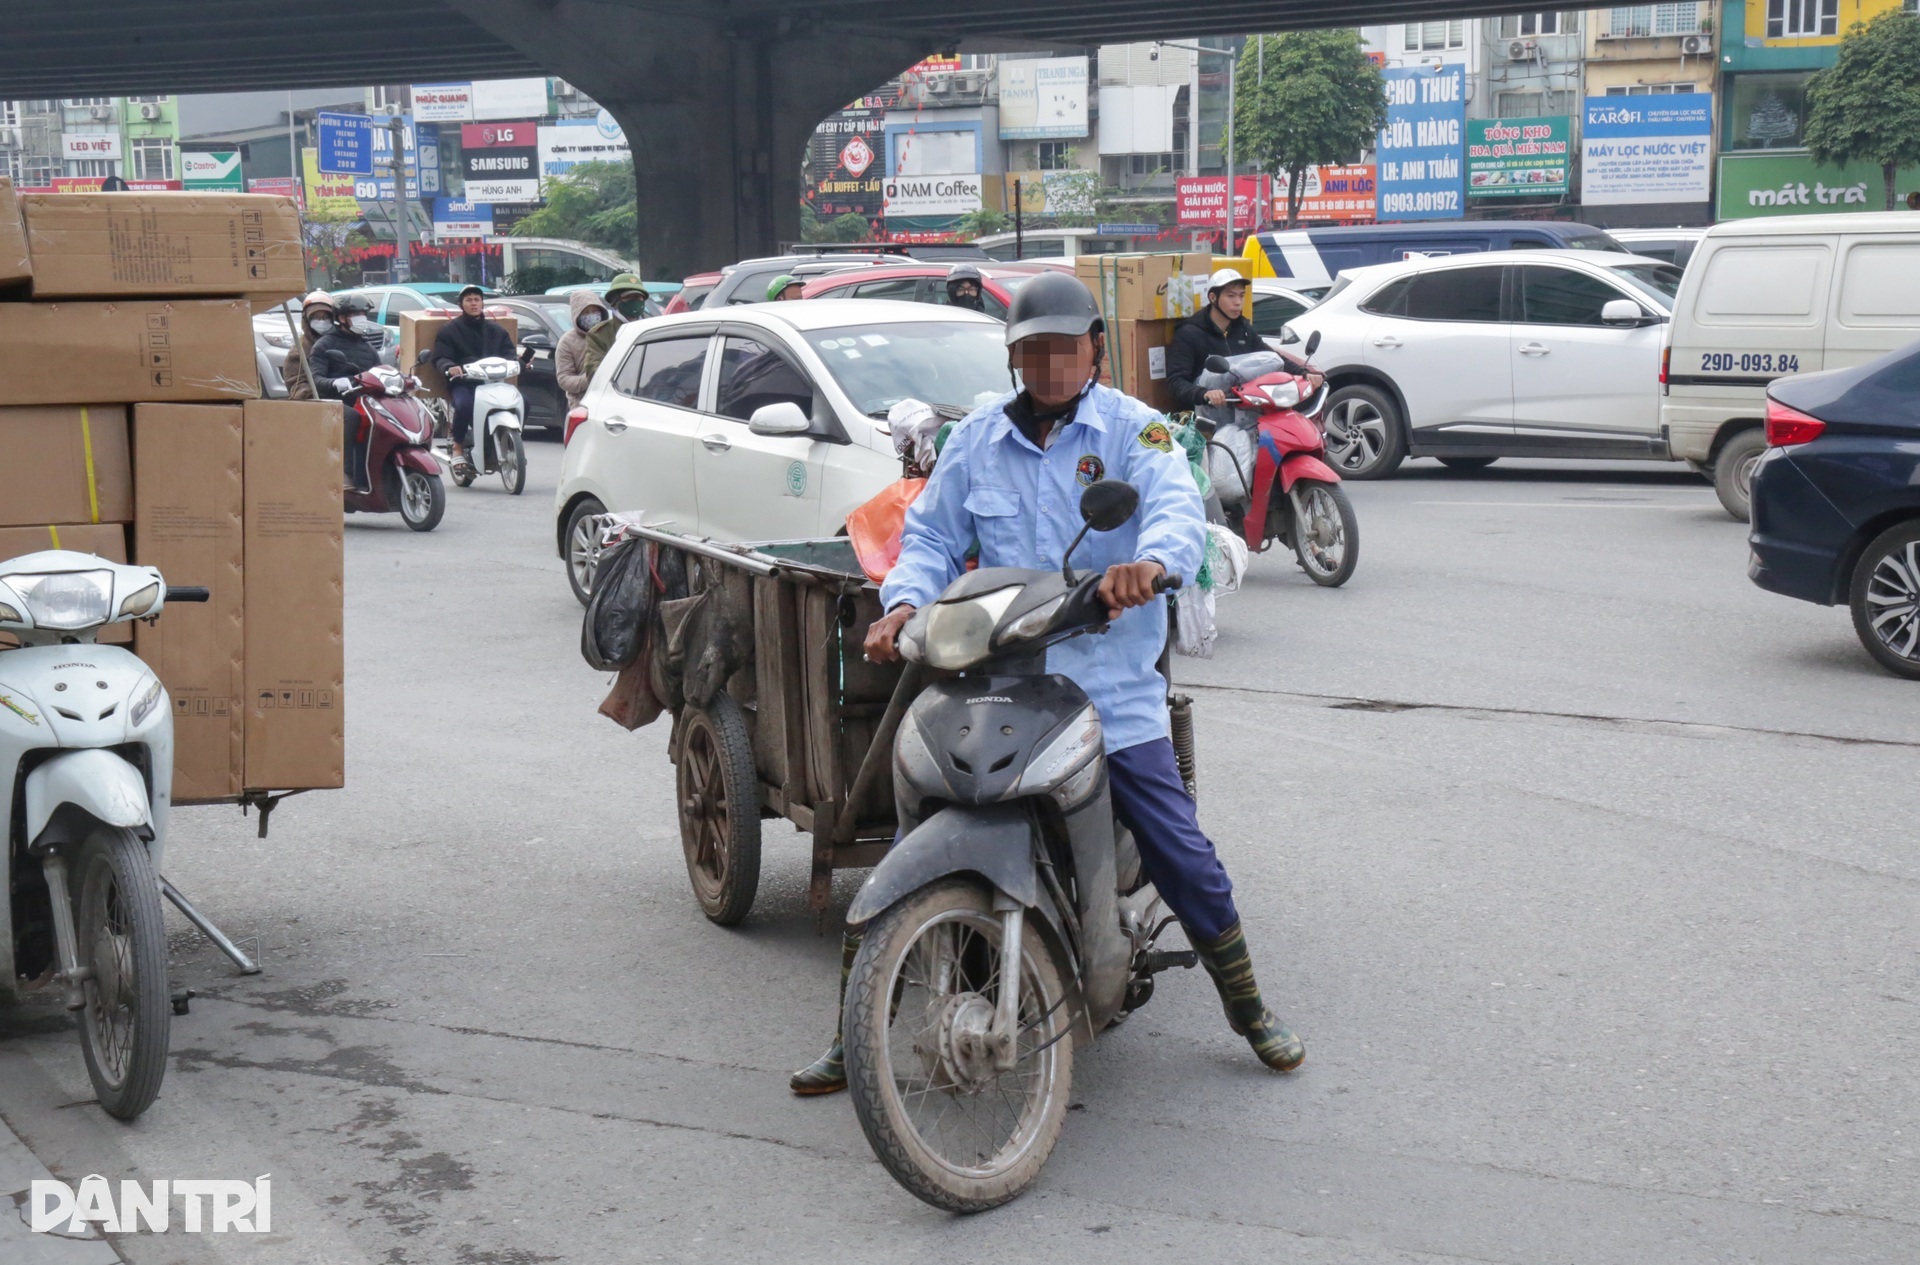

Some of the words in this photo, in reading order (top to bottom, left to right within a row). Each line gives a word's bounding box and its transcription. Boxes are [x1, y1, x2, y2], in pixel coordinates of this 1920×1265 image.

[1384, 78, 1416, 106] CHO
[1420, 70, 1460, 104] THUÊ
[438, 94, 468, 103] QUANG
[1588, 108, 1641, 124] KAROFI
[344, 120, 357, 128] CAO
[839, 122, 843, 133] 7
[1484, 121, 1520, 141] TỔNG
[1522, 125, 1552, 139] KHO
[497, 129, 514, 142] LG
[1382, 116, 1413, 149] CỬA
[1417, 116, 1459, 147] HÀNG
[70, 142, 88, 151] LED
[91, 139, 112, 152] VIỆT
[551, 145, 567, 153] CÔNG
[1469, 145, 1492, 157] HOA
[1492, 140, 1514, 158] QUẢ
[1542, 141, 1566, 154] NAM
[1588, 144, 1614, 157] MÁY
[1618, 145, 1640, 158] LỌC
[1643, 142, 1676, 155] NƯỚC
[1679, 141, 1706, 156] VIỆT
[193, 162, 216, 170] Castrol
[470, 157, 529, 171] SAMSUNG
[1383, 162, 1399, 181] LH:
[1402, 161, 1425, 180] ANH
[1428, 153, 1458, 179] TUẤN
[355, 182, 377, 198] 60
[482, 184, 504, 195] HÙNG
[506, 186, 522, 194] ANH
[834, 181, 859, 192] BUFFET
[864, 178, 880, 192] LẨU
[901, 183, 931, 198] NAM
[936, 180, 978, 197] Coffee
[1180, 182, 1203, 194] QUÁN
[1204, 182, 1226, 194] NƯỚC
[1324, 180, 1348, 192] ANH
[1351, 177, 1373, 194] LỘC
[1184, 196, 1200, 206] GIẢI
[1202, 195, 1224, 206] KHÁT
[1749, 182, 1810, 206] mát
[1814, 182, 1868, 204] trà
[448, 201, 475, 212] simon
[1383, 191, 1458, 213] 0903.801972
[1181, 208, 1200, 219] BÁNH
[1215, 208, 1227, 218] XÔI
[1701, 353, 1799, 372] 29D-093.84
[52, 662, 97, 670] HONDA
[966, 696, 1014, 704] HONDA
